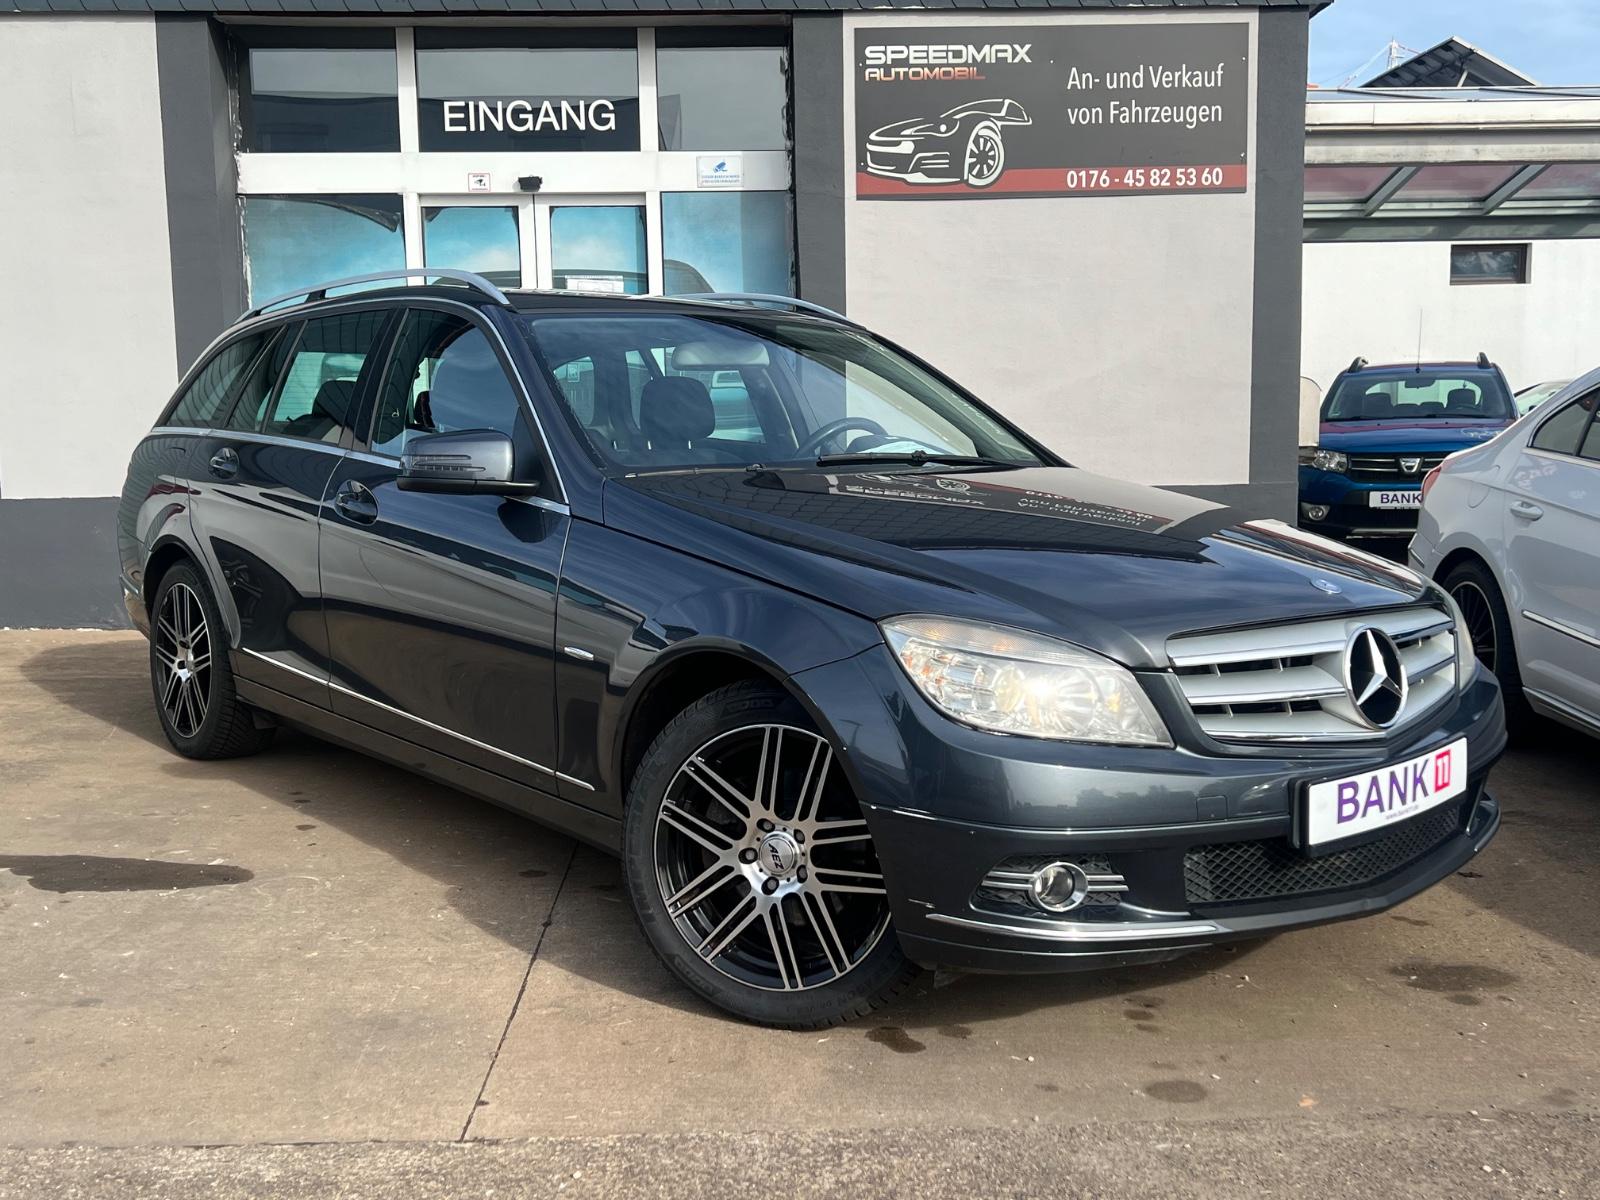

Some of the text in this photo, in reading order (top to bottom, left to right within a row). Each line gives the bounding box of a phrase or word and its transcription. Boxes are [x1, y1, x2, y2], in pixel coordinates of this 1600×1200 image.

[864, 44, 1032, 65] SPEEDMAX
[864, 66, 986, 81] AUTOMOBIL
[1066, 62, 1225, 90] An- und Verkauf
[442, 99, 617, 132] EINGANG
[1067, 99, 1222, 129] von Fahrzeugen
[1066, 170, 1110, 188] 0176
[1123, 169, 1145, 187] 45
[1149, 168, 1171, 187] 82
[1175, 168, 1197, 186] 53
[1201, 167, 1223, 186] 60
[1380, 492, 1424, 504] BANK
